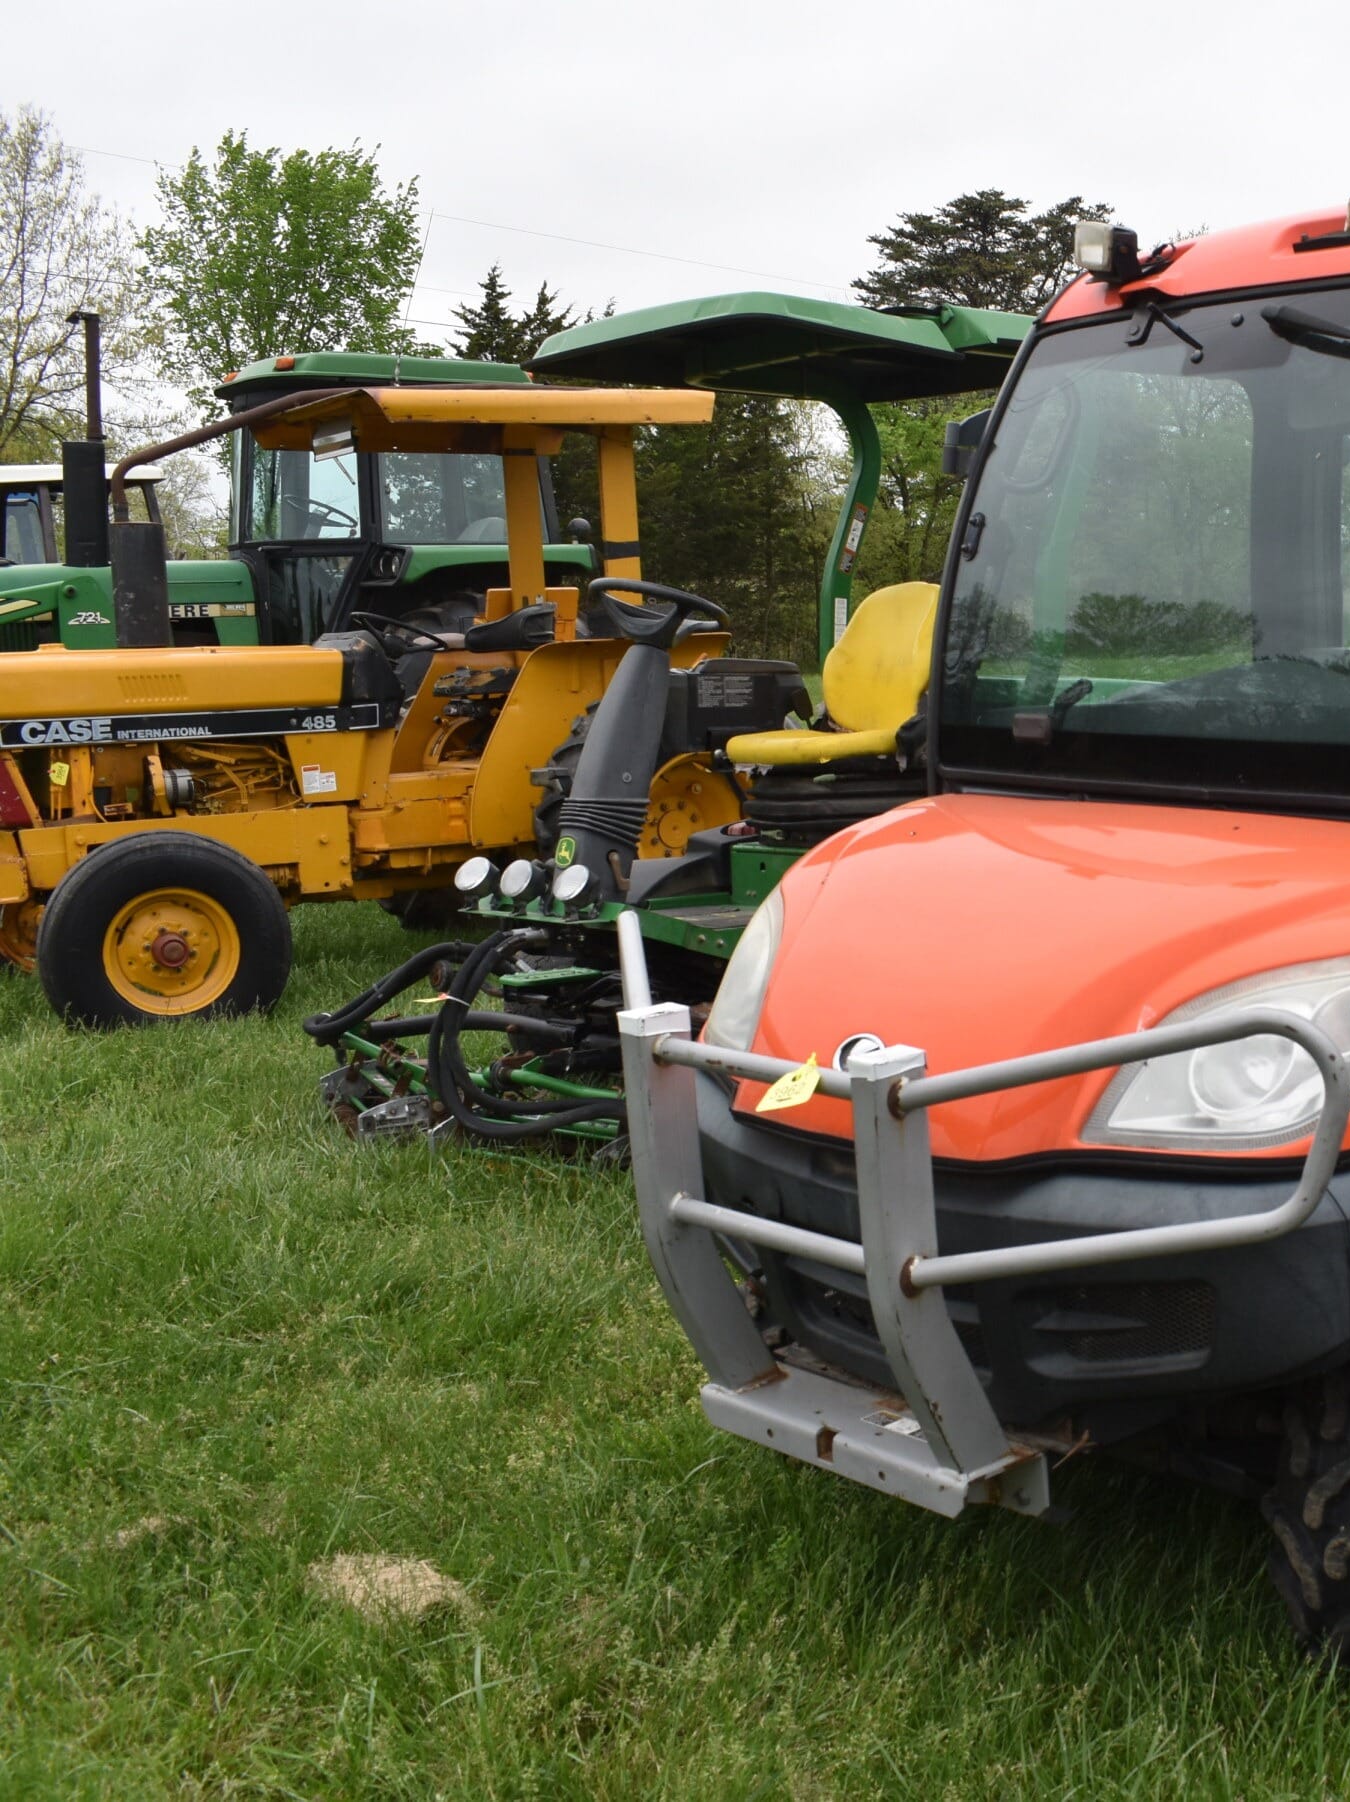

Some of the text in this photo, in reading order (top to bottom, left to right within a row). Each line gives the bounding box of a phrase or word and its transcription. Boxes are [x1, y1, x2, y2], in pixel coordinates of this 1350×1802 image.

[77, 611, 101, 622] 721
[170, 604, 210, 618] ERE
[301, 714, 336, 730] 485
[20, 718, 212, 744] CASE INTERNATIONAL
